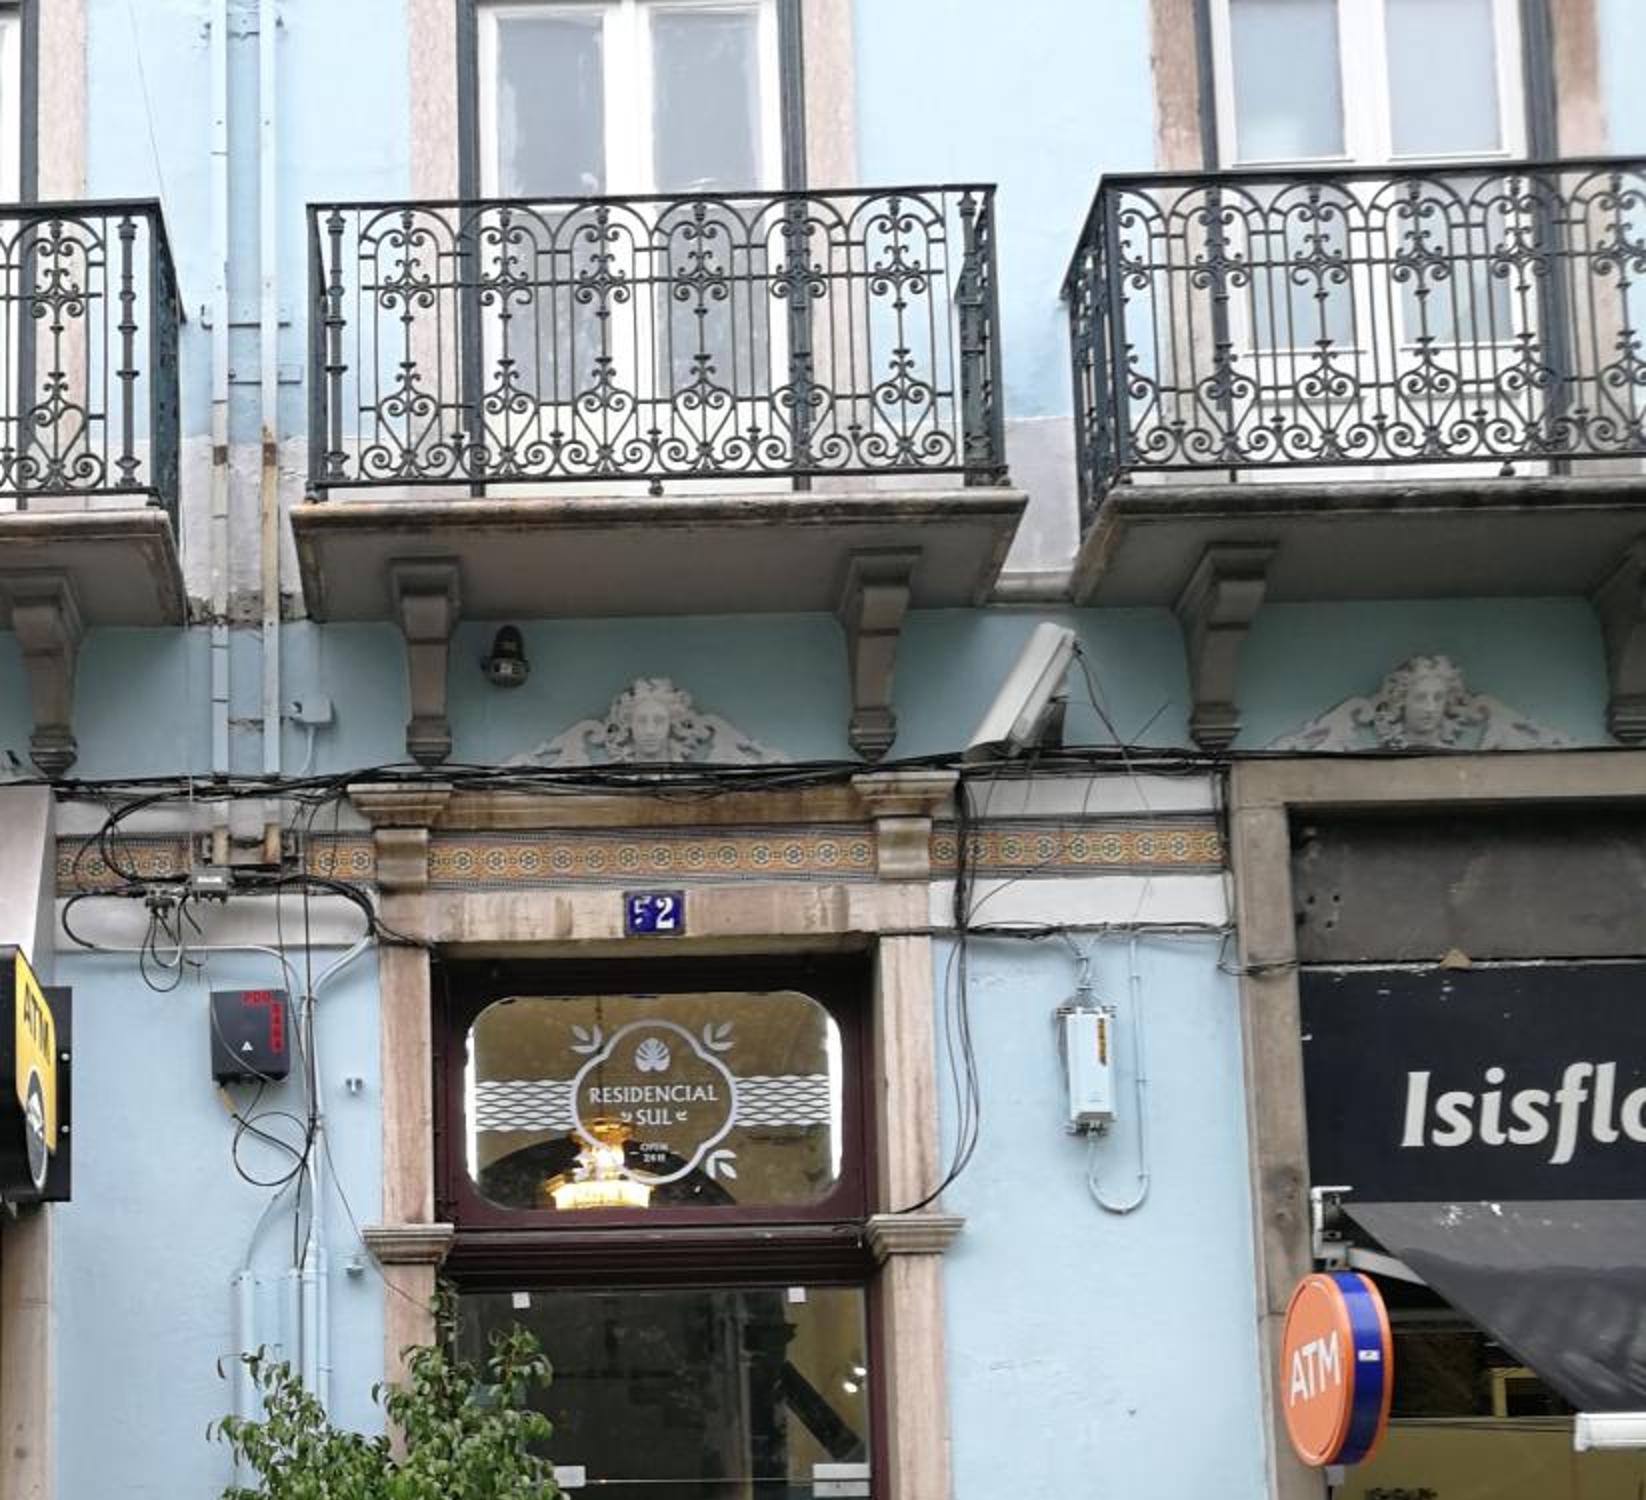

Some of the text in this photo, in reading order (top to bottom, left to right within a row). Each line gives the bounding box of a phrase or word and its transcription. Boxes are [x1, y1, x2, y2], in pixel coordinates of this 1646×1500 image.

[633, 896, 675, 929] 52
[23, 981, 51, 1067] ATM
[589, 1084, 719, 1104] RESIDENCIAL
[636, 1108, 673, 1126] SUL
[1289, 1329, 1341, 1409] ATM
